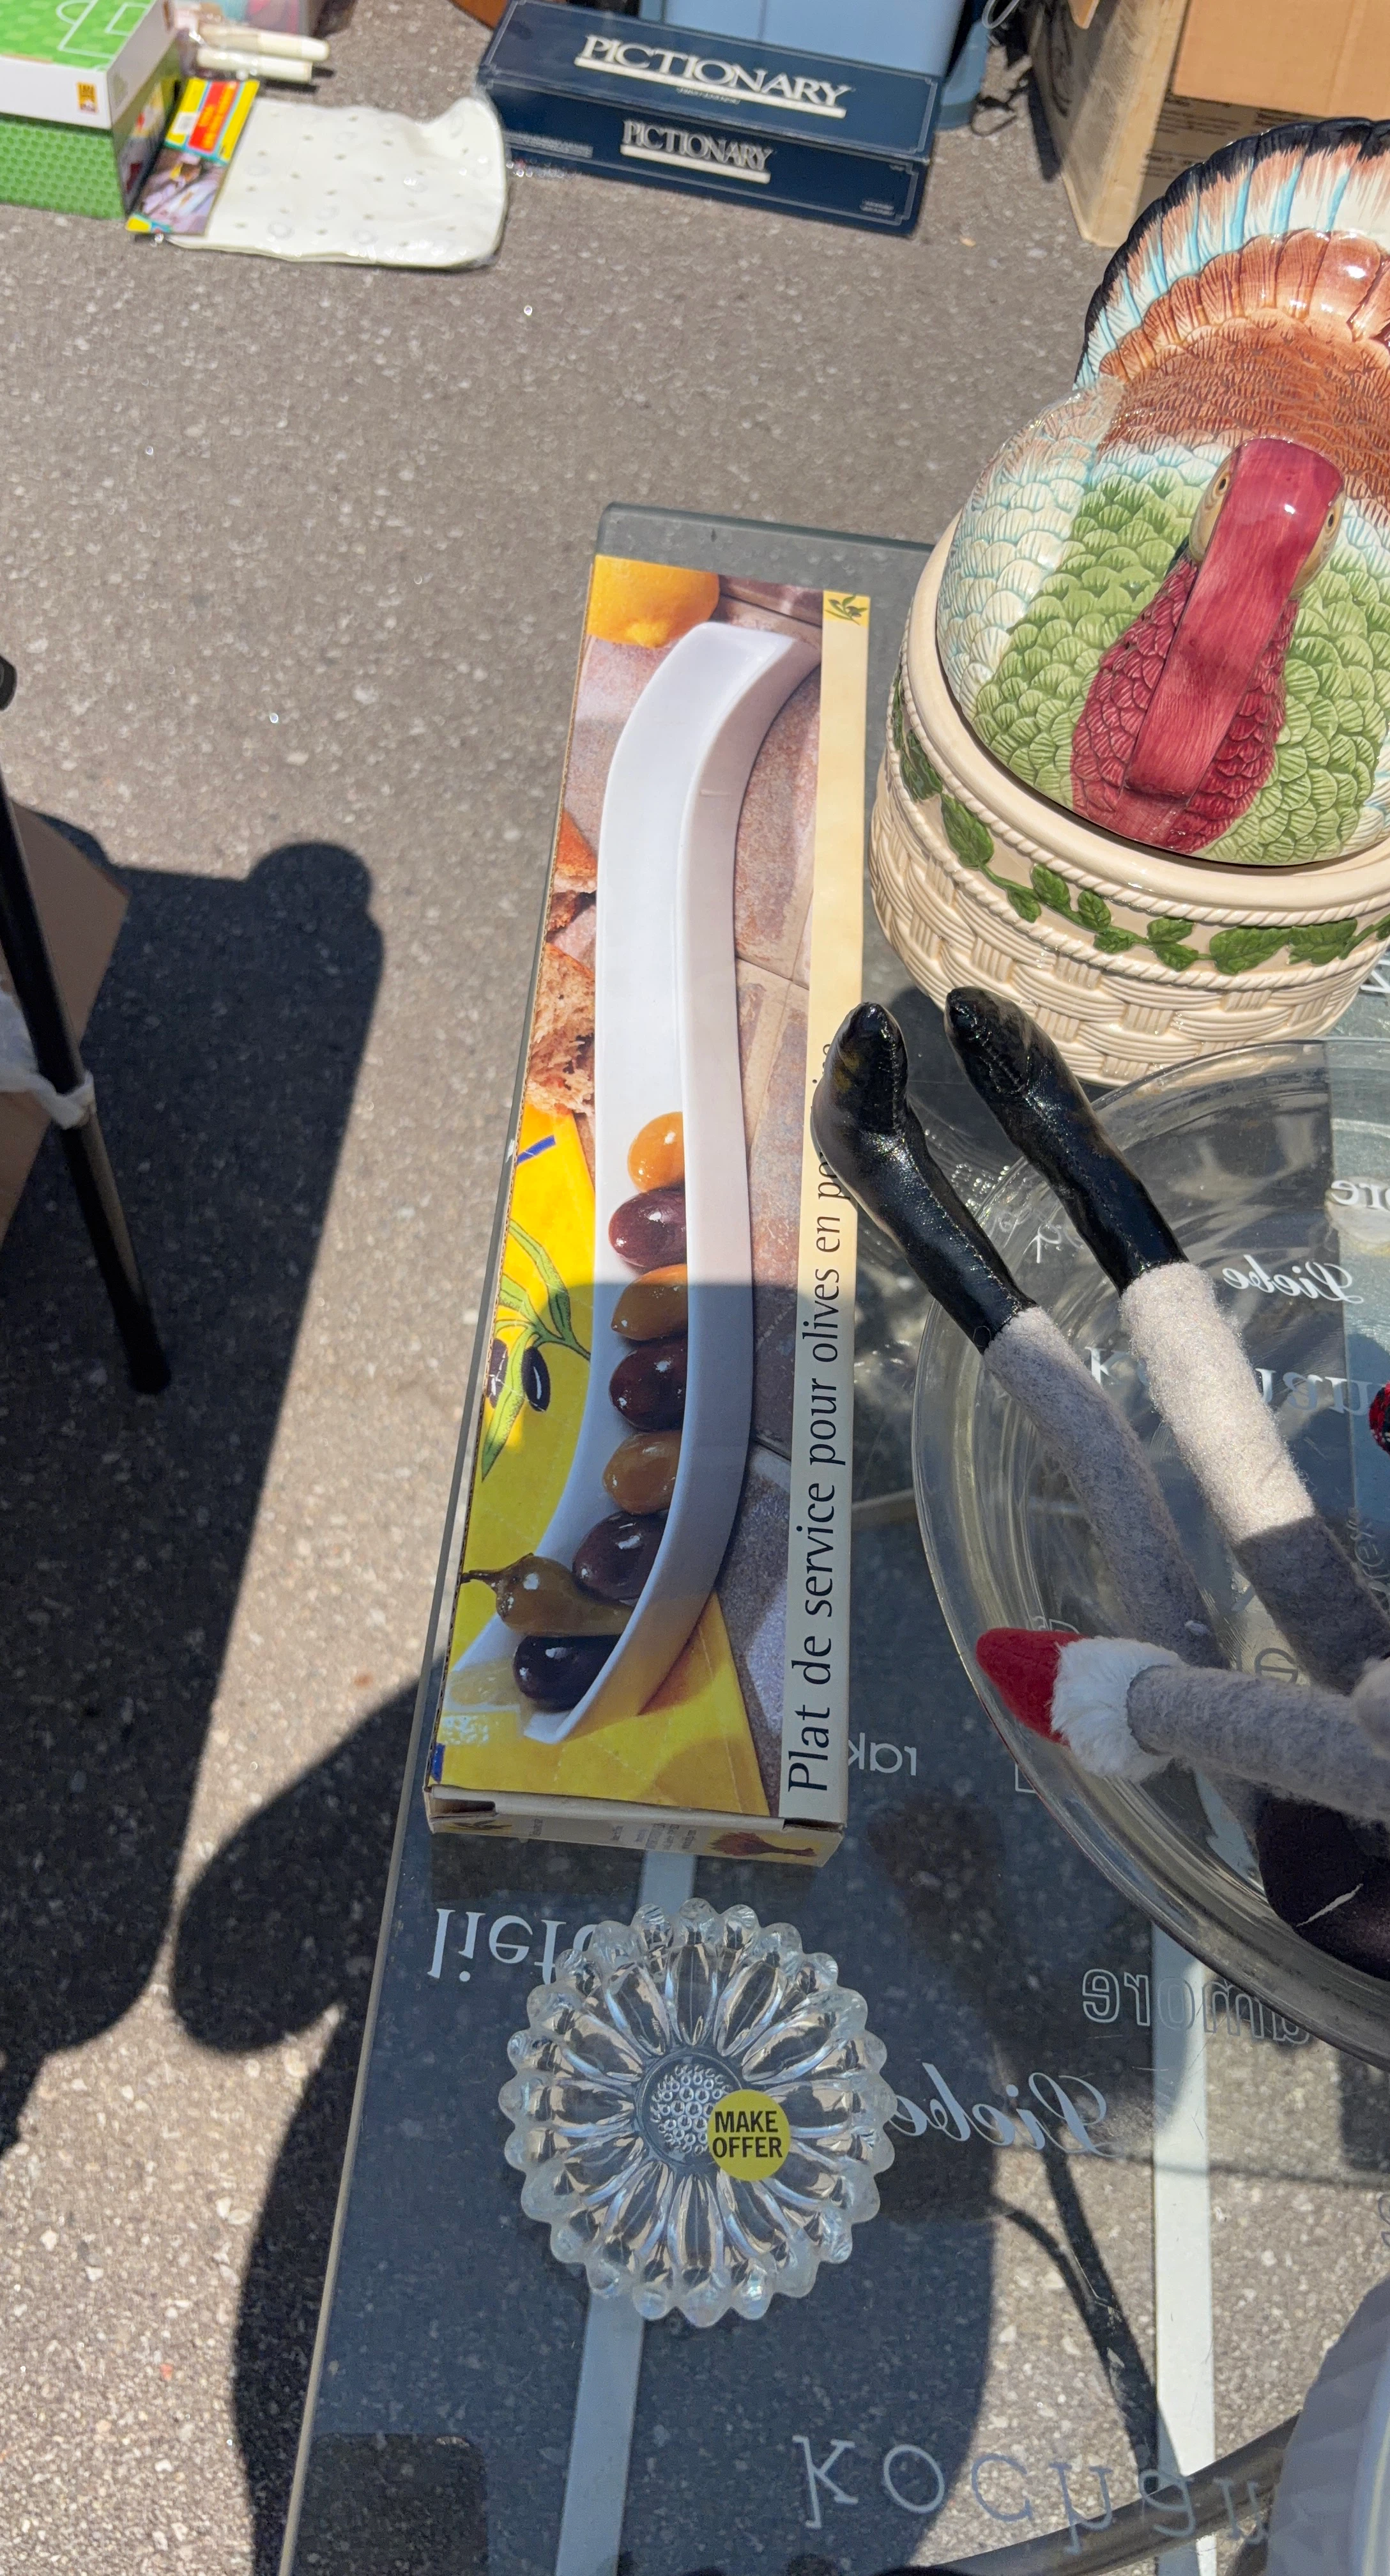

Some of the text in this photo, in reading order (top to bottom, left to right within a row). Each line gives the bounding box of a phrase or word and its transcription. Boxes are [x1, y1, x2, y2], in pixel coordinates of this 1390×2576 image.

[579, 34, 850, 107] PICTIONARY
[623, 121, 771, 172] PICTIONARY
[816, 1216, 841, 1252] en
[802, 1269, 839, 1362] olives
[809, 1378, 846, 1466] pour
[796, 1483, 840, 1617] service
[791, 1636, 831, 1685] de
[788, 1705, 830, 1791] Plat
[712, 2136, 783, 2158] OFFER
[715, 2110, 779, 2133] MAKE
